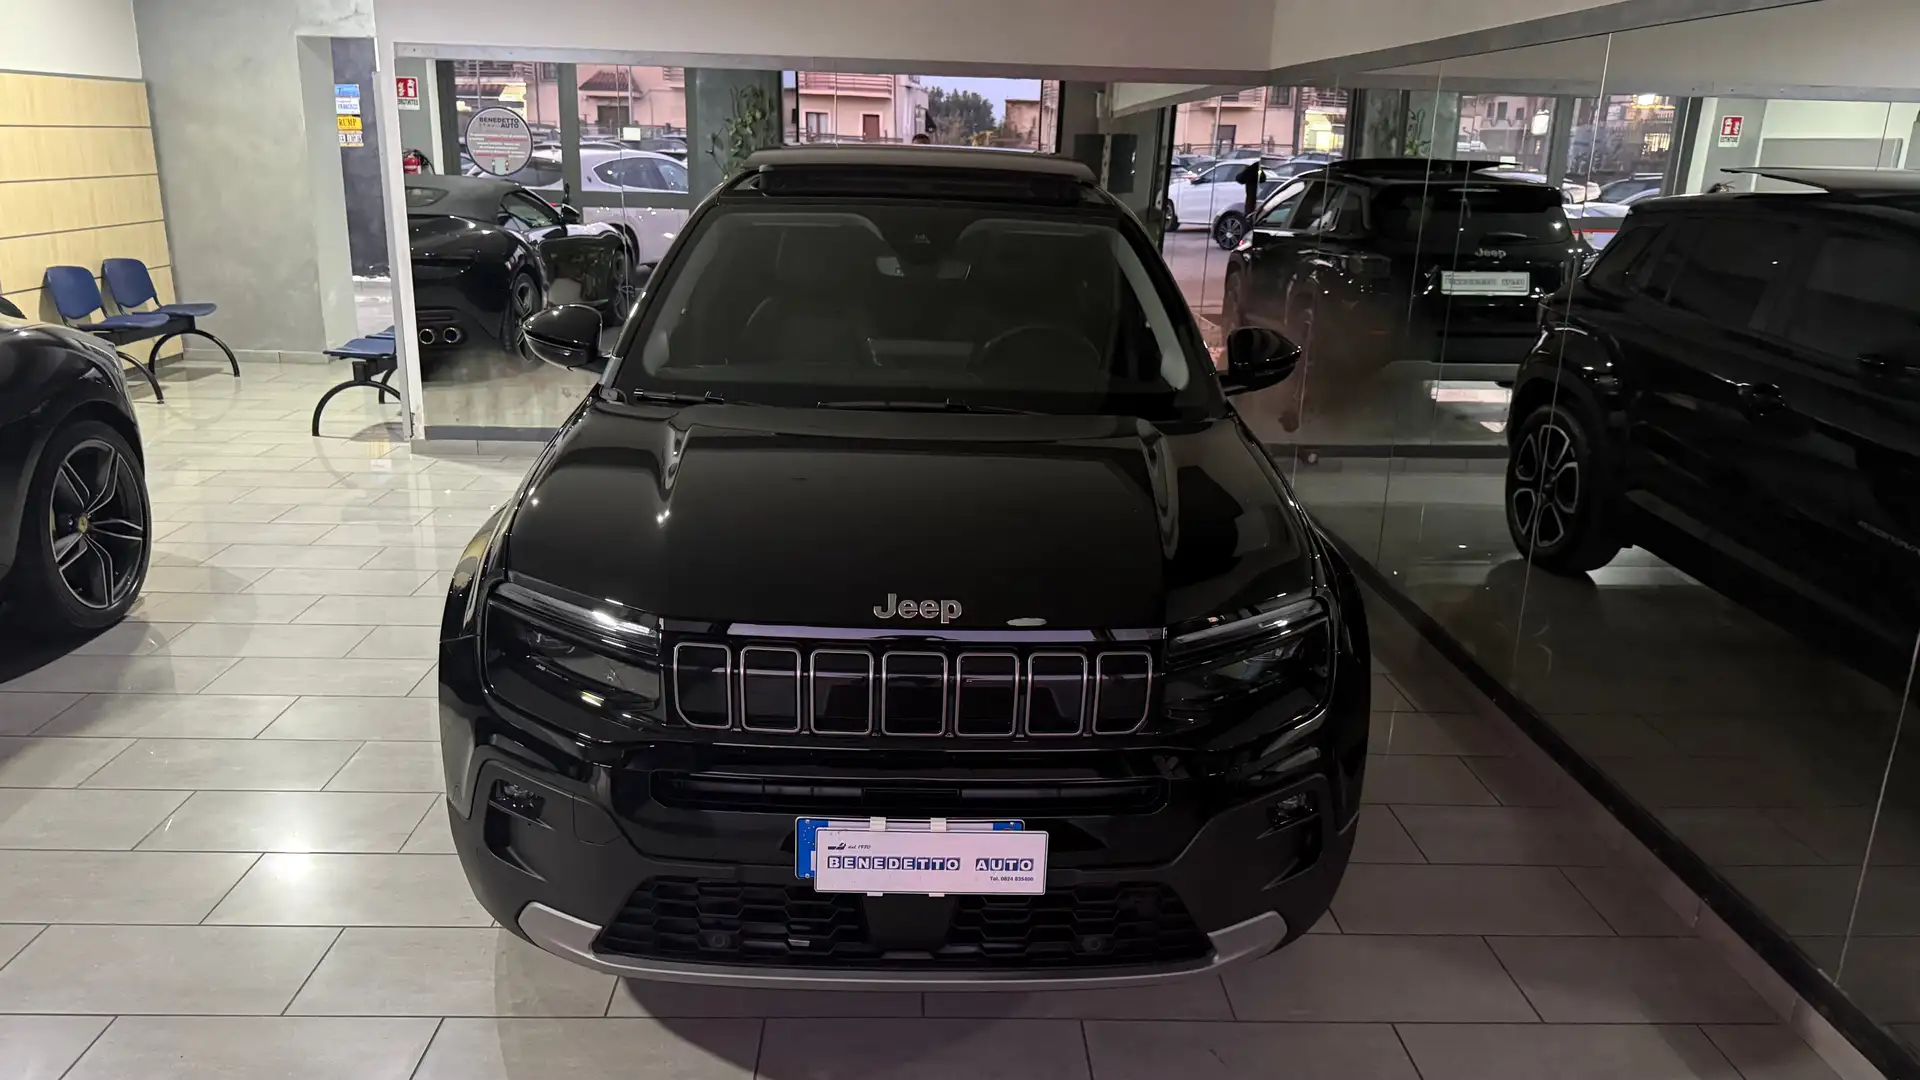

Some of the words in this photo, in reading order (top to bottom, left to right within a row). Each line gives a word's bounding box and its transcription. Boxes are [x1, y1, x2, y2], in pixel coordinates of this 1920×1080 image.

[1474, 248, 1507, 259] Jeep
[873, 593, 962, 624] Jeep
[827, 856, 961, 871] BENEDETTO
[975, 857, 1034, 872] AUTO
